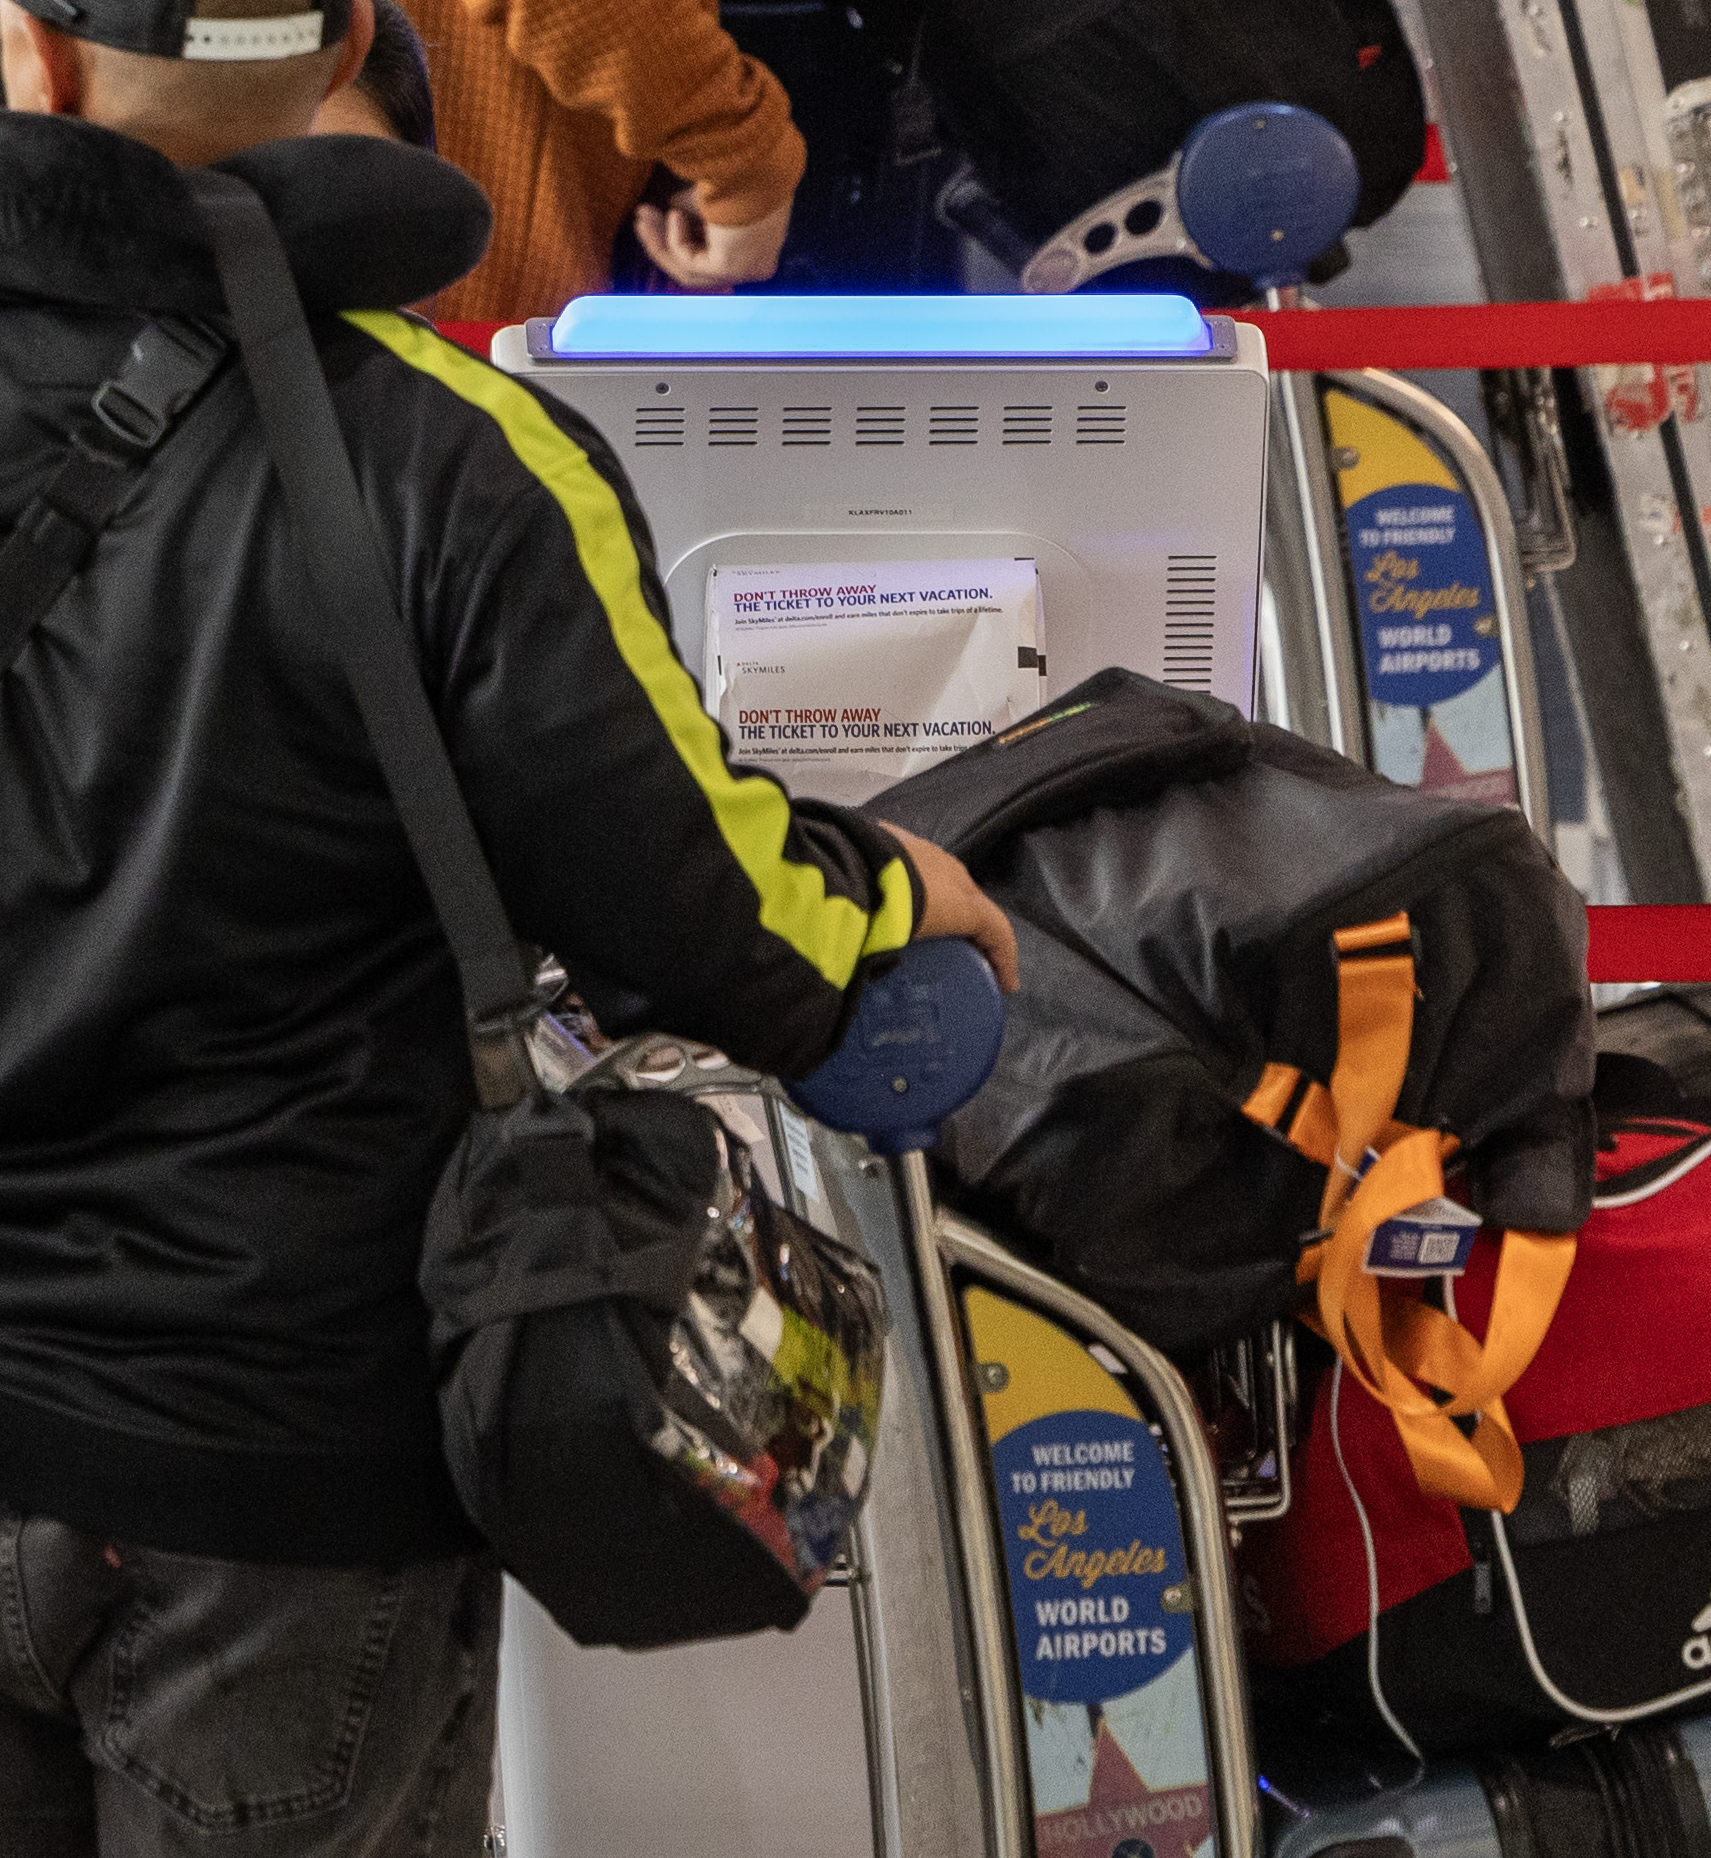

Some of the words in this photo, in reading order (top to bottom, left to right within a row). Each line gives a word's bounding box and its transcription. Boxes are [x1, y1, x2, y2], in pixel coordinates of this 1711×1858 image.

[1376, 506, 1455, 527] WELCOME
[734, 591, 776, 603] DON'T
[780, 587, 832, 600] THROW
[836, 584, 877, 596] AWAY
[734, 602, 761, 613] THE
[764, 598, 811, 611] TICKET
[815, 596, 834, 608] TO
[838, 594, 876, 607] YOUR
[880, 592, 915, 604] NEXT
[919, 588, 993, 602] VACATION.
[1379, 623, 1453, 649] WORLD
[742, 666, 785, 674] SKYMILES
[1378, 648, 1481, 675] AIRPORTS
[739, 710, 781, 724] DON'T
[785, 709, 837, 723] THROW
[841, 708, 881, 722] AWAY
[739, 726, 765, 739] THE
[769, 725, 816, 739] TICKET
[820, 724, 838, 738] TO
[842, 724, 880, 738] YOUR
[884, 723, 919, 737] NEXT
[923, 721, 995, 736] VACATION.
[1032, 1441, 1136, 1468] WELCOME
[1011, 1472, 1036, 1495] TO
[1040, 1468, 1135, 1494] FRIENDLY
[1017, 1499, 1088, 1547] Los
[1024, 1540, 1167, 1590] Angeles
[1035, 1596, 1130, 1628] WORLD
[1035, 1628, 1168, 1662] AIRPORTS
